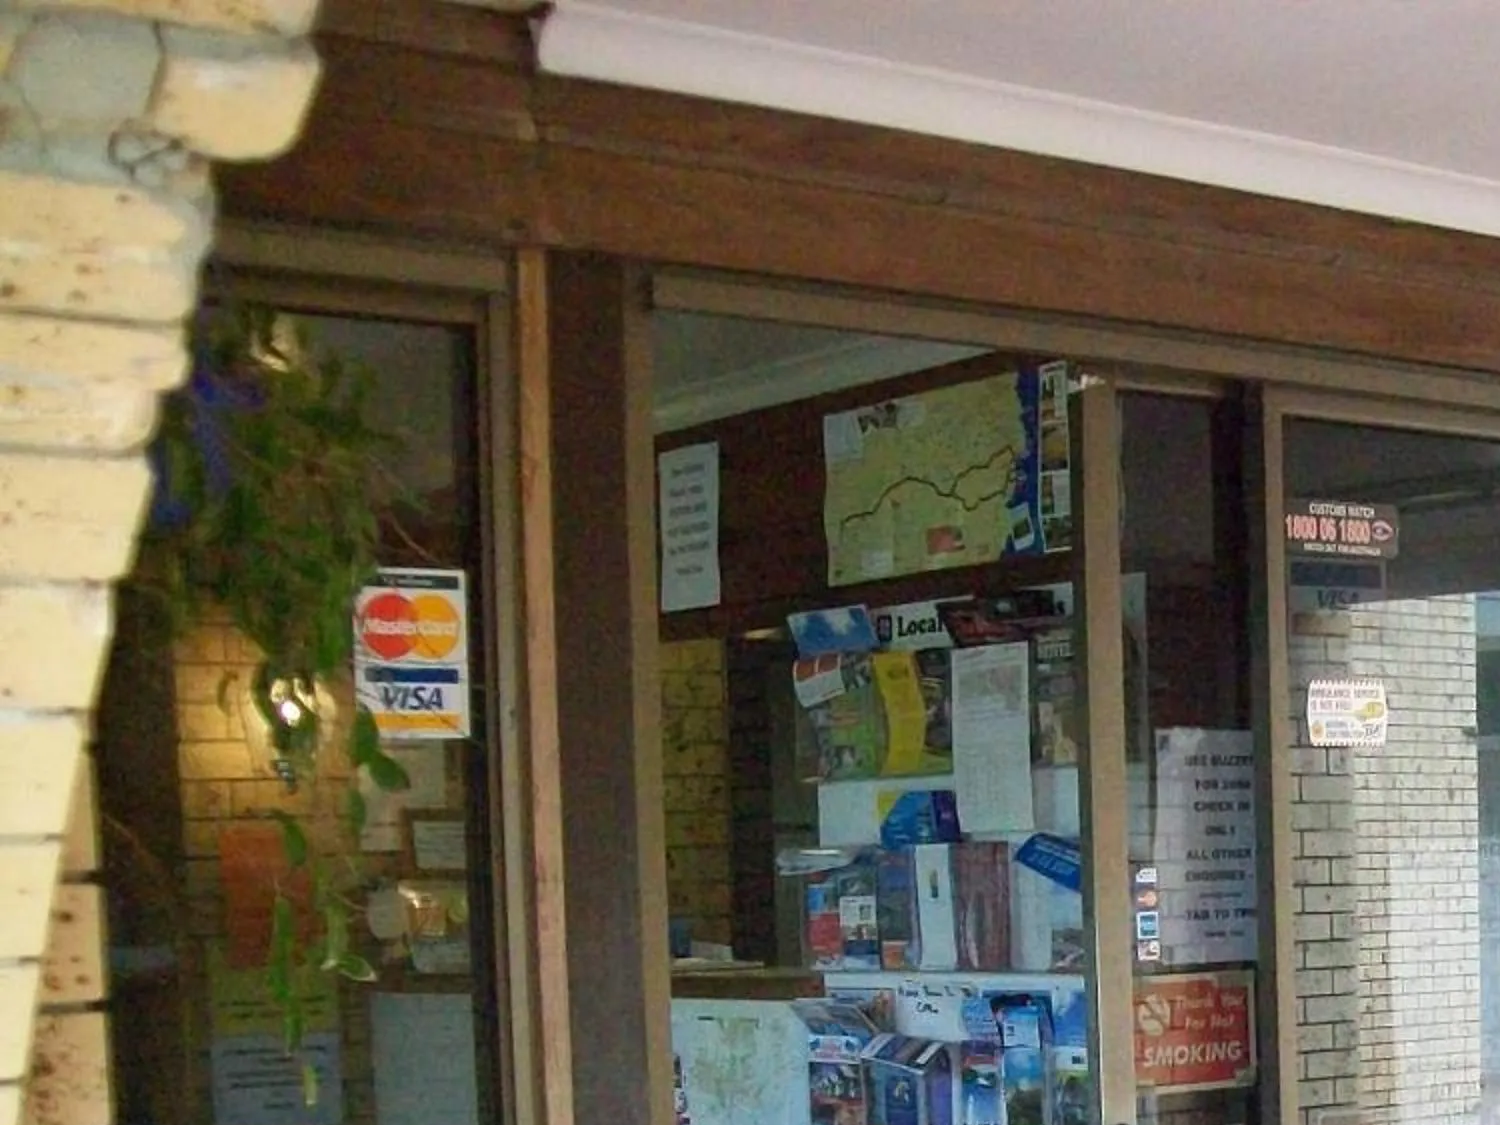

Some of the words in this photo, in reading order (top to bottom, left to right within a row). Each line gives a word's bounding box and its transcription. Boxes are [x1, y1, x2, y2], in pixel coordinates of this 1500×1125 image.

[1285, 513, 1317, 540] 1800
[1319, 516, 1337, 541] 06
[897, 615, 944, 637] Local
[382, 685, 444, 711] VISA
[1143, 1040, 1243, 1067] SMOKING
